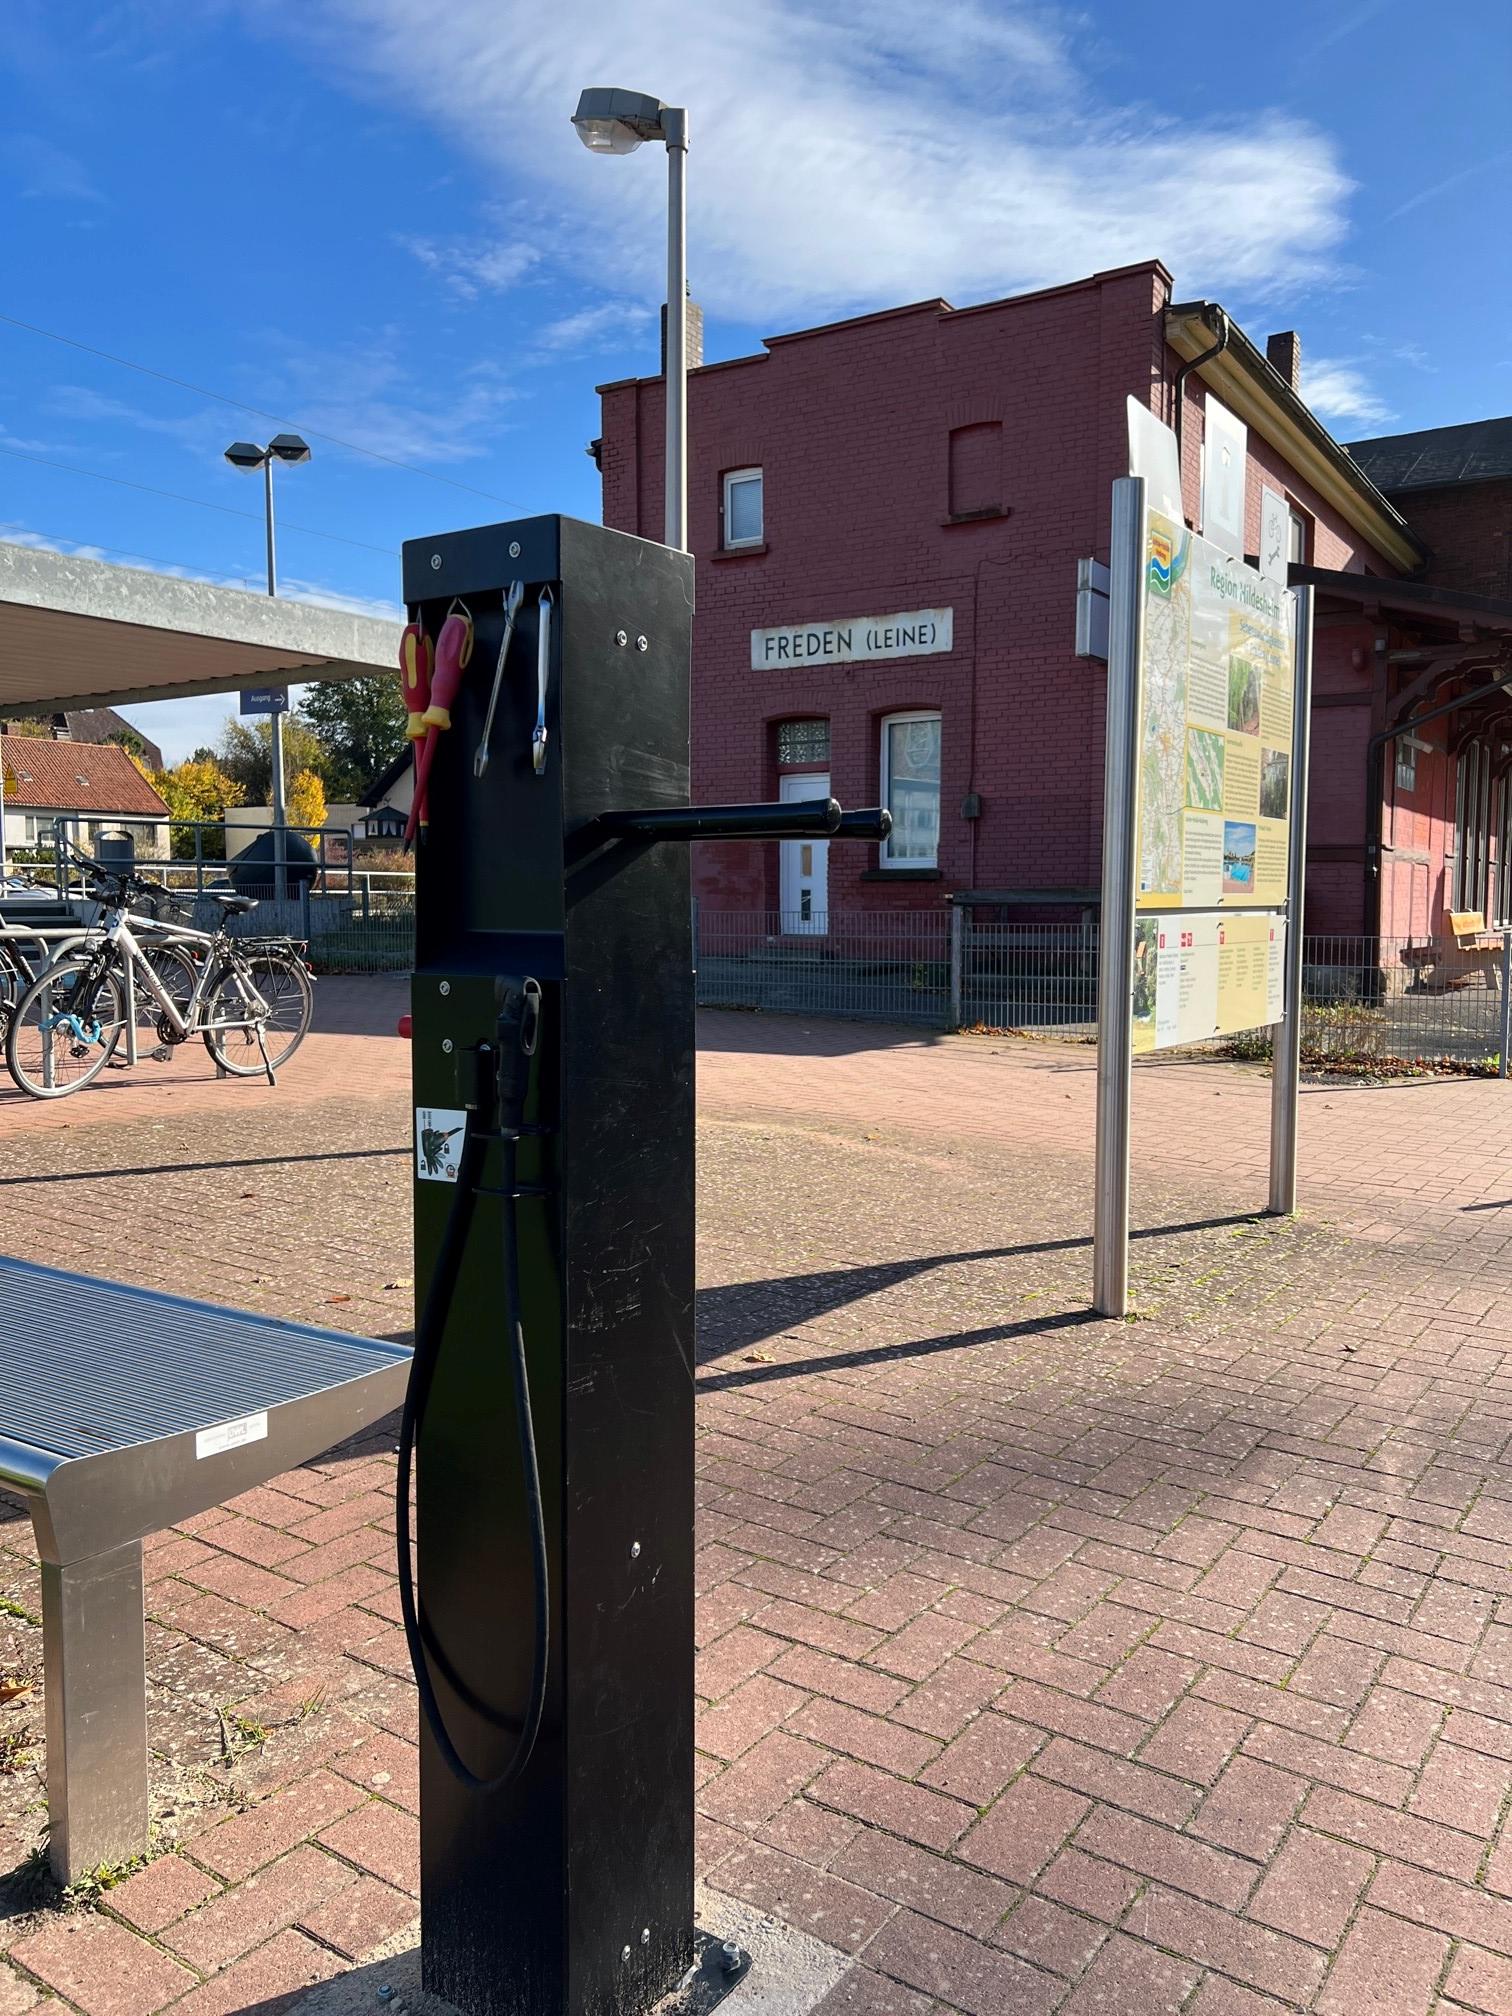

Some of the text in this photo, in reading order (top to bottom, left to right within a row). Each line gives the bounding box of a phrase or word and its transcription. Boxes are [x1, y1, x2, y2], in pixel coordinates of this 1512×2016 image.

[1210, 566, 1280, 621] Region Hildesheim
[764, 623, 937, 661] FREDEN (LEINE)
[250, 694, 271, 703] Ausgang
